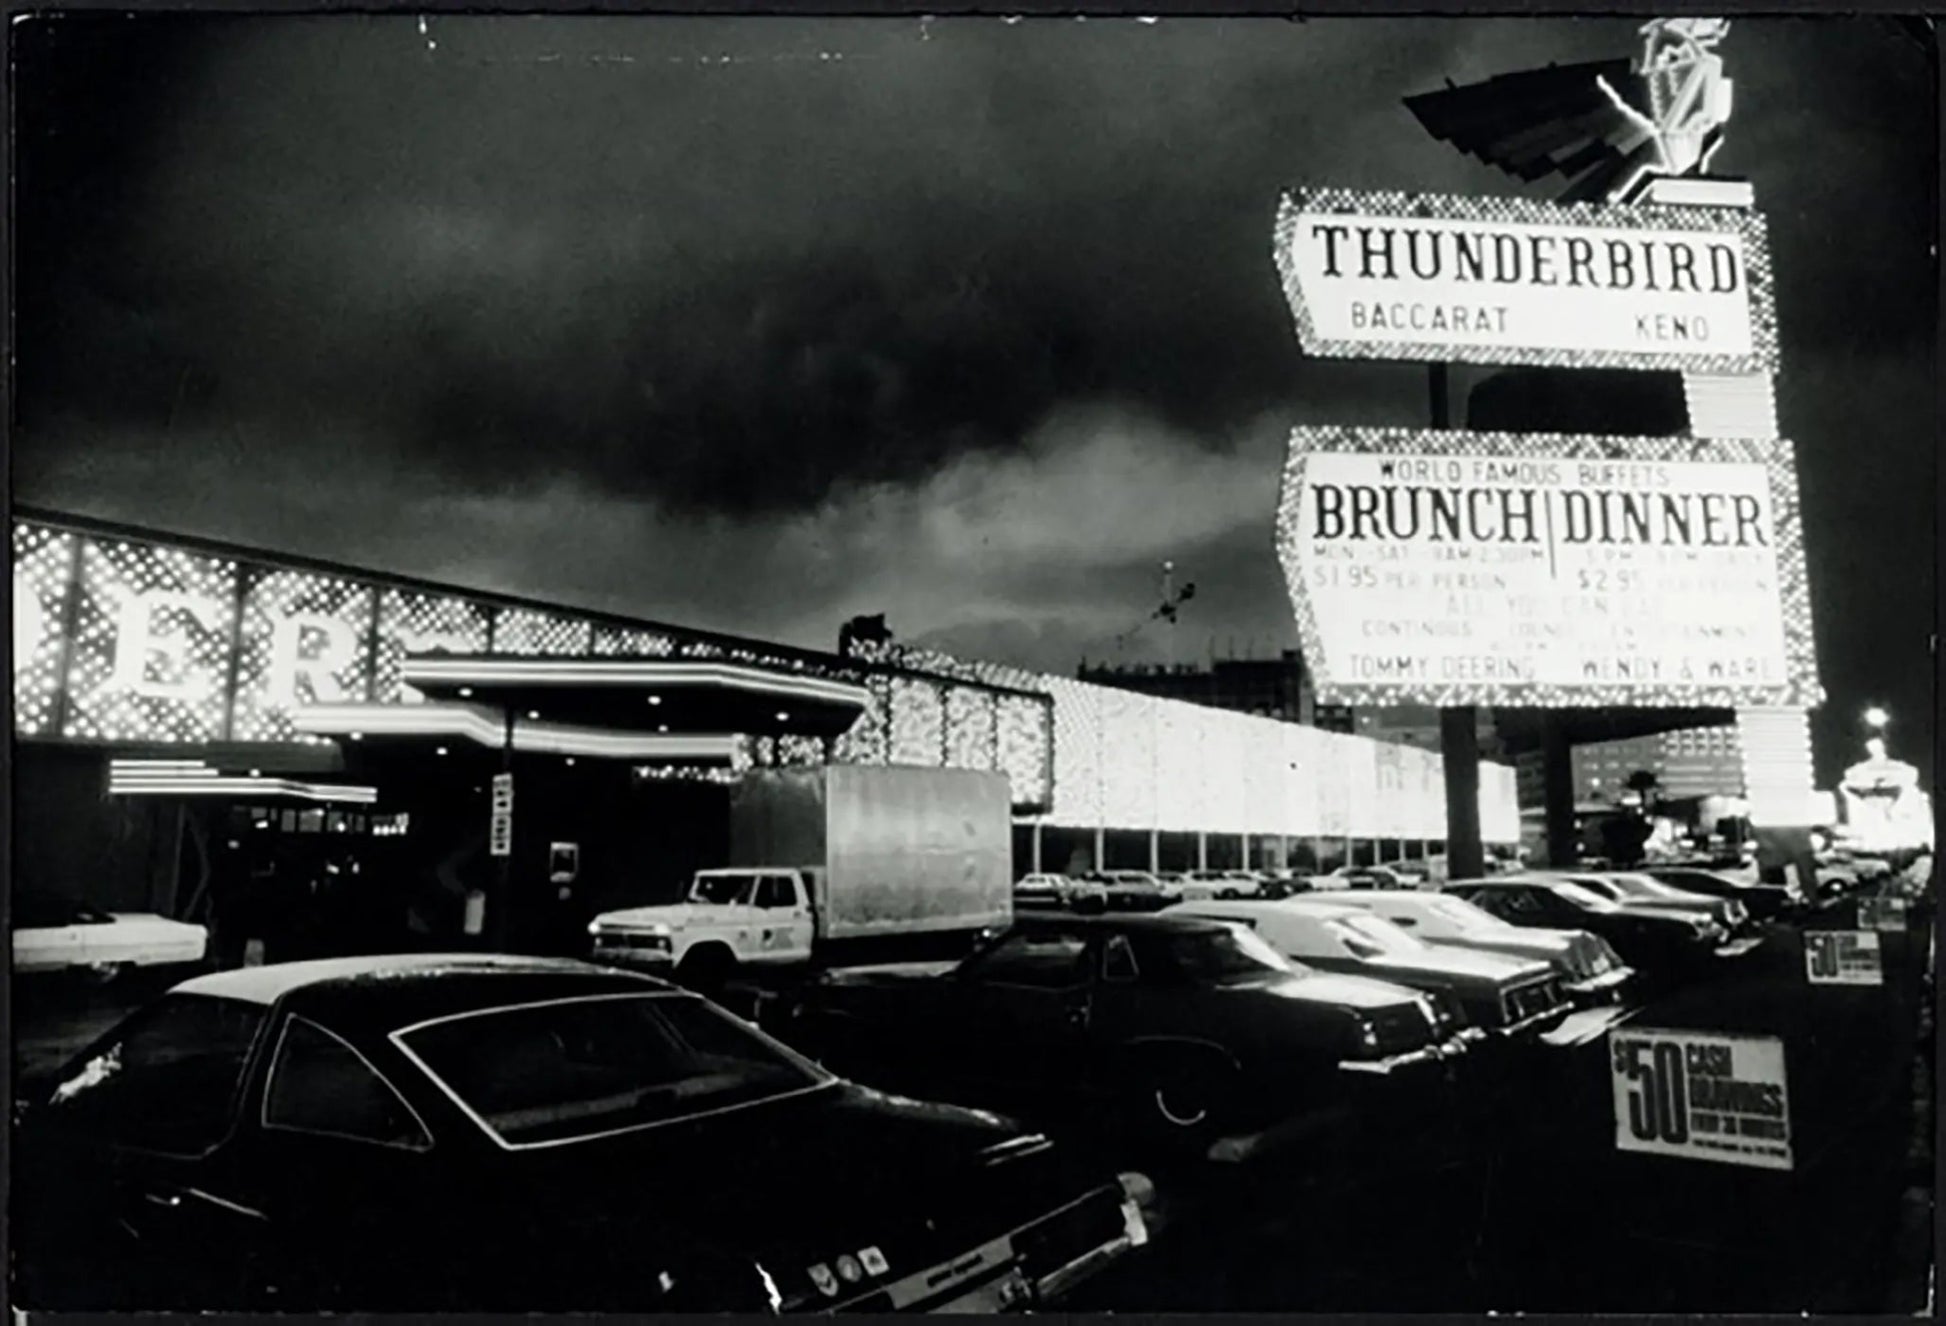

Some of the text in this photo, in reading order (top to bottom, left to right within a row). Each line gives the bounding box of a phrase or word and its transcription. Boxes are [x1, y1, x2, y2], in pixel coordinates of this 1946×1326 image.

[1312, 224, 1738, 295] THUNDERBIRD
[1351, 302, 1710, 342] BACCARAT KENO
[1380, 460, 1671, 488] WORLD FAMOUS BUFFETS
[1310, 483, 1769, 547] BRUNCH DINNER
[1349, 653, 1429, 680] TOMMY
[1441, 654, 1536, 681] DEERING
[1581, 656, 1661, 680] WENDY
